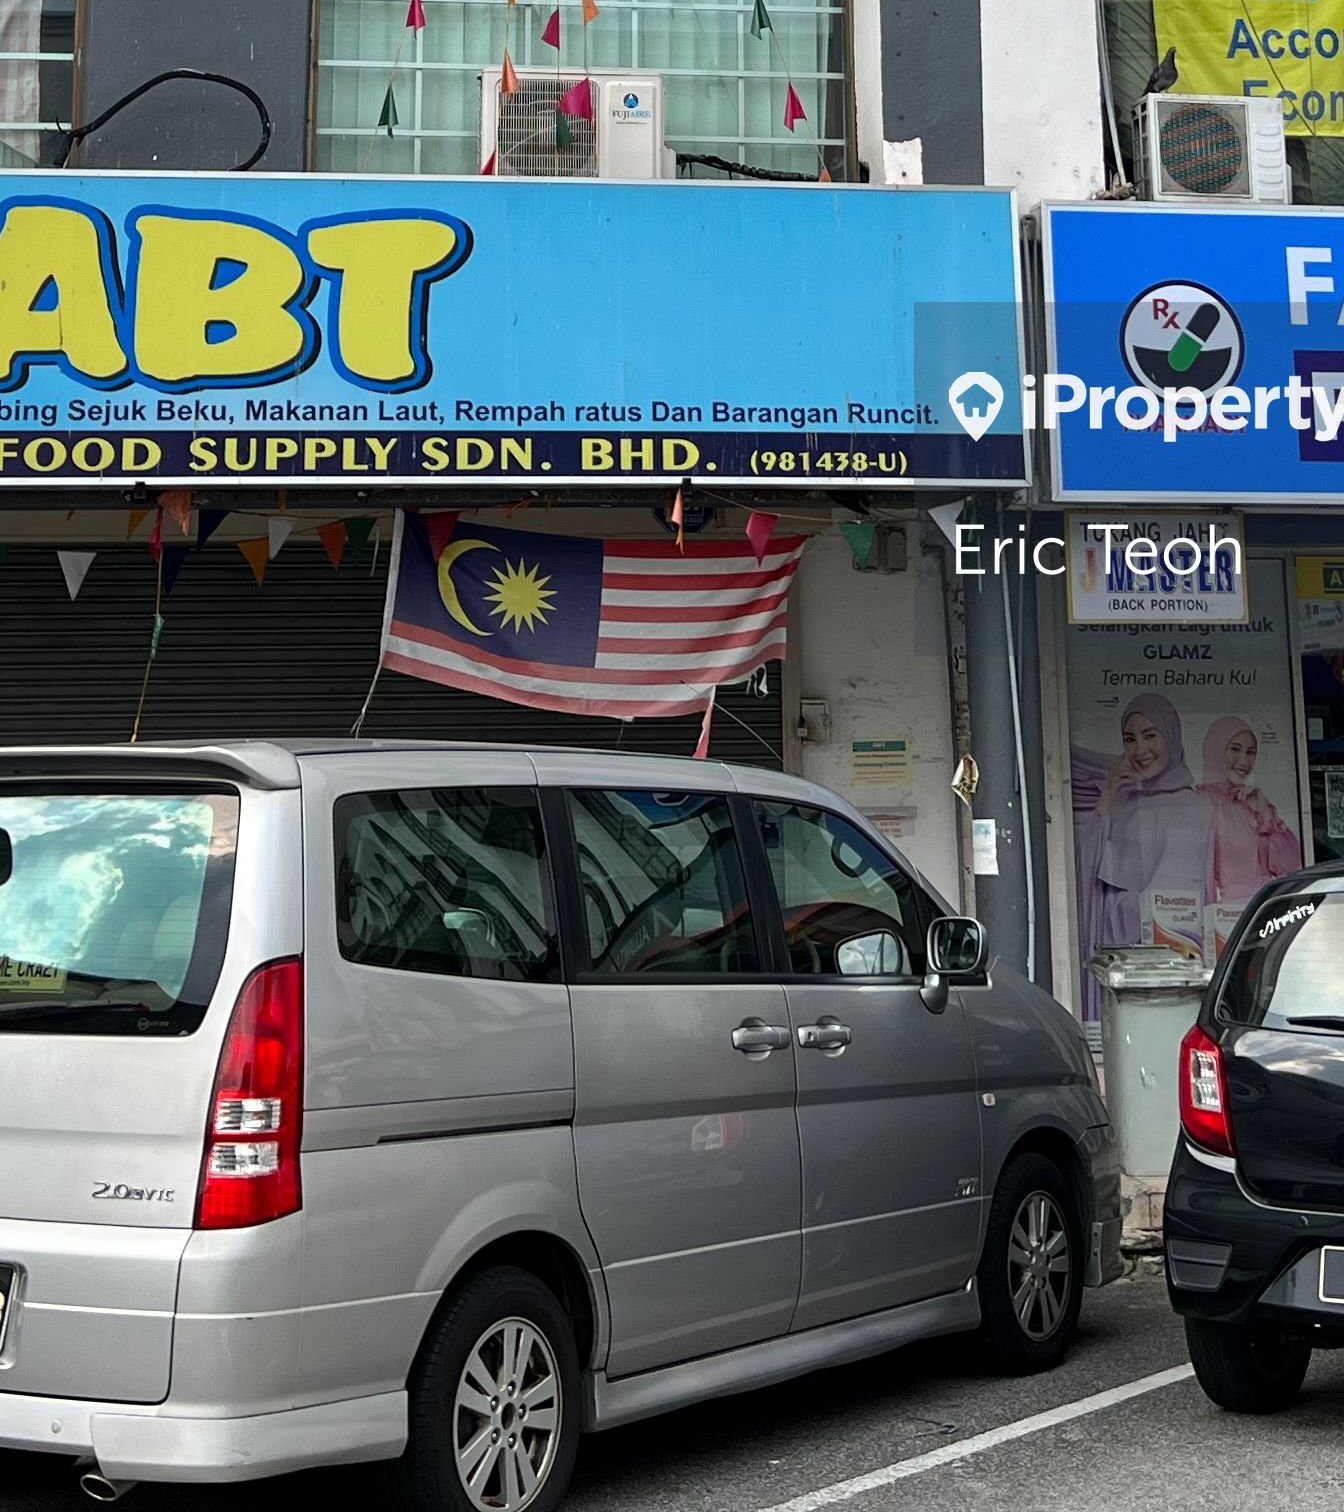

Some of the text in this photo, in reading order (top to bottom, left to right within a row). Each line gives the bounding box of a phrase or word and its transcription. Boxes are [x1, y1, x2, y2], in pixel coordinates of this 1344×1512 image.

[68, 399, 147, 426] Sejuk
[156, 400, 234, 424] Beku,
[245, 400, 368, 422] Makanan
[379, 401, 445, 424] Laut,
[456, 401, 565, 426] Rempah
[575, 402, 641, 422] ratus
[652, 402, 702, 422] Dan
[712, 402, 837, 428] Barangan
[848, 403, 939, 424] Runcit.
[189, 437, 397, 473] SUPPLY
[421, 436, 552, 473] SDN.
[581, 437, 717, 473] BHD.
[750, 450, 907, 475] (981438-U)
[1108, 599, 1208, 612] (BACK PORTION)
[1143, 644, 1213, 660] GLAMZ
[1101, 669, 1257, 686] Teman Baharu Ku!
